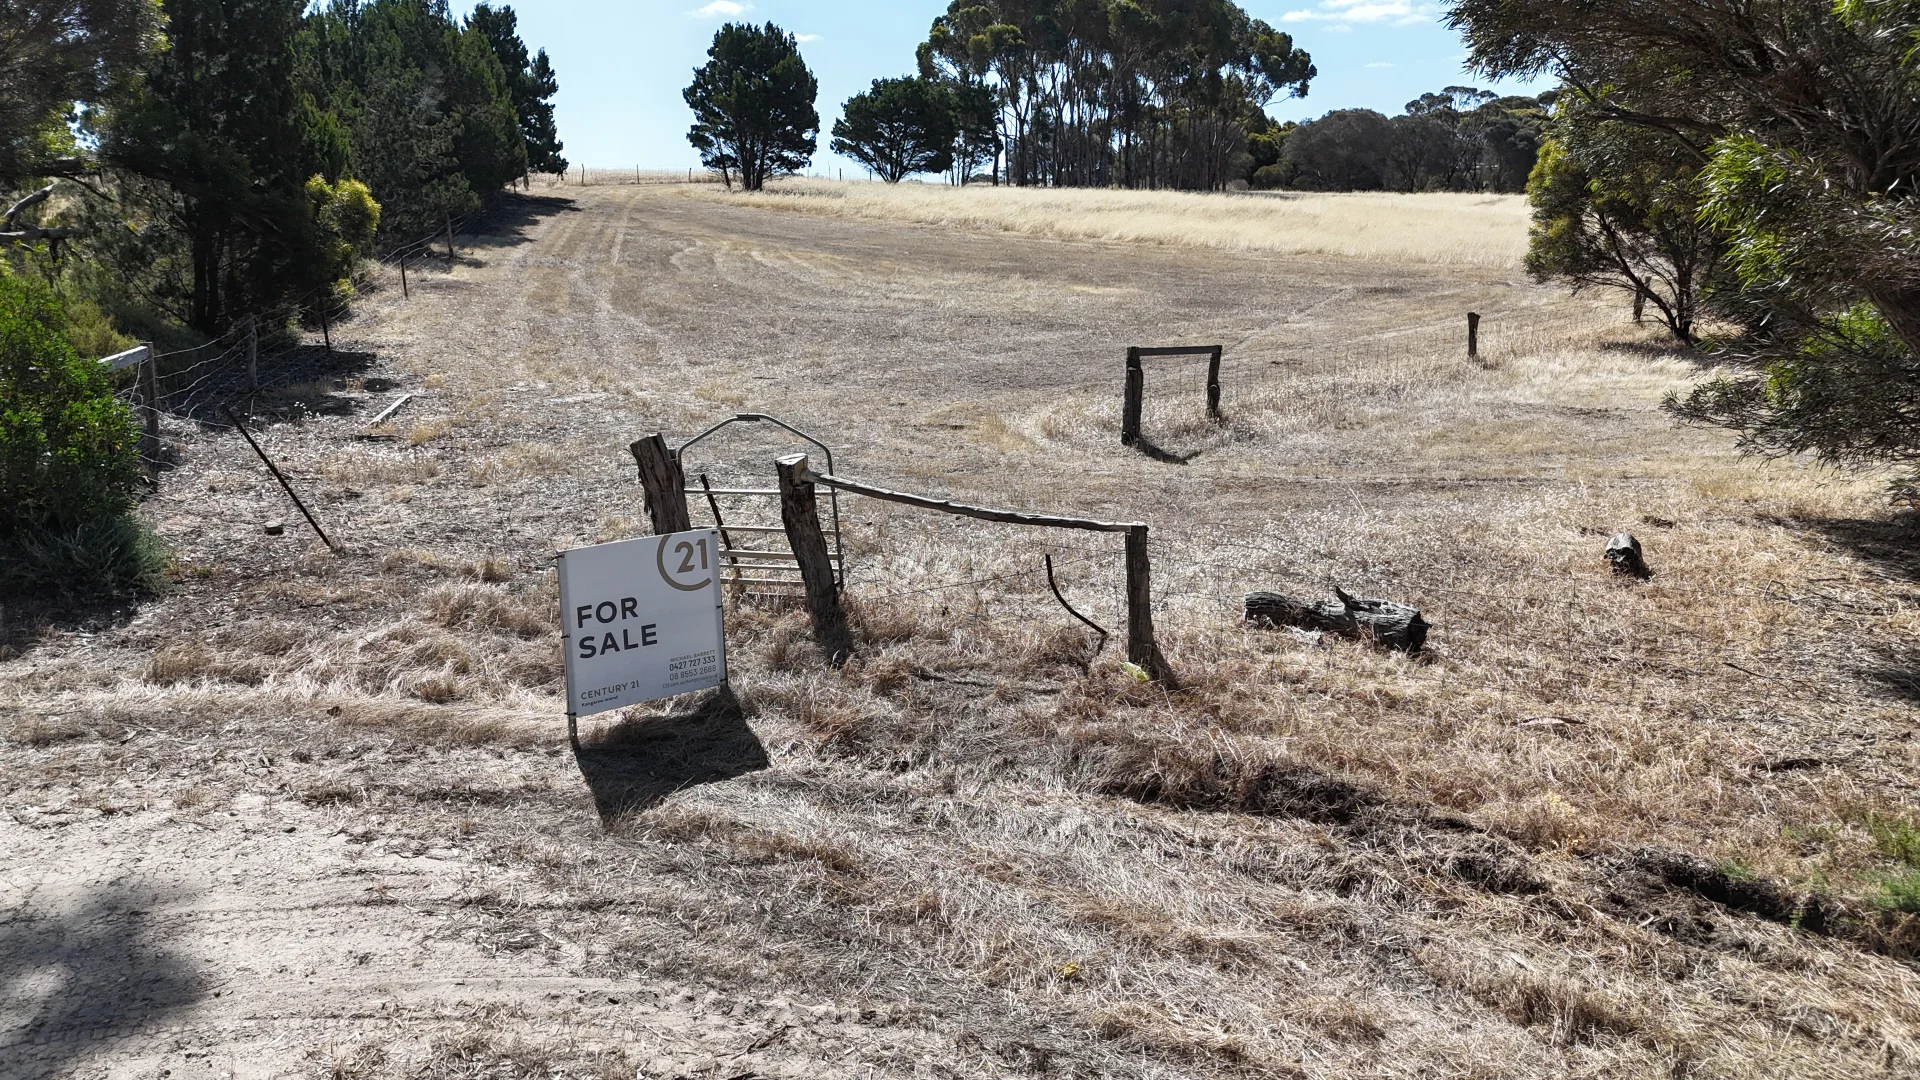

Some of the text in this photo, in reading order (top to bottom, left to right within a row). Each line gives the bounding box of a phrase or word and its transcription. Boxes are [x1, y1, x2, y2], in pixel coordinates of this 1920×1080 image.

[577, 597, 639, 629] FOR
[579, 623, 658, 659] SALE
[669, 655, 716, 671] 0427 727 333
[669, 664, 717, 681] 08 8553 2688
[580, 680, 640, 700] CENTURY 21
[581, 699, 604, 707] Kangaroo
